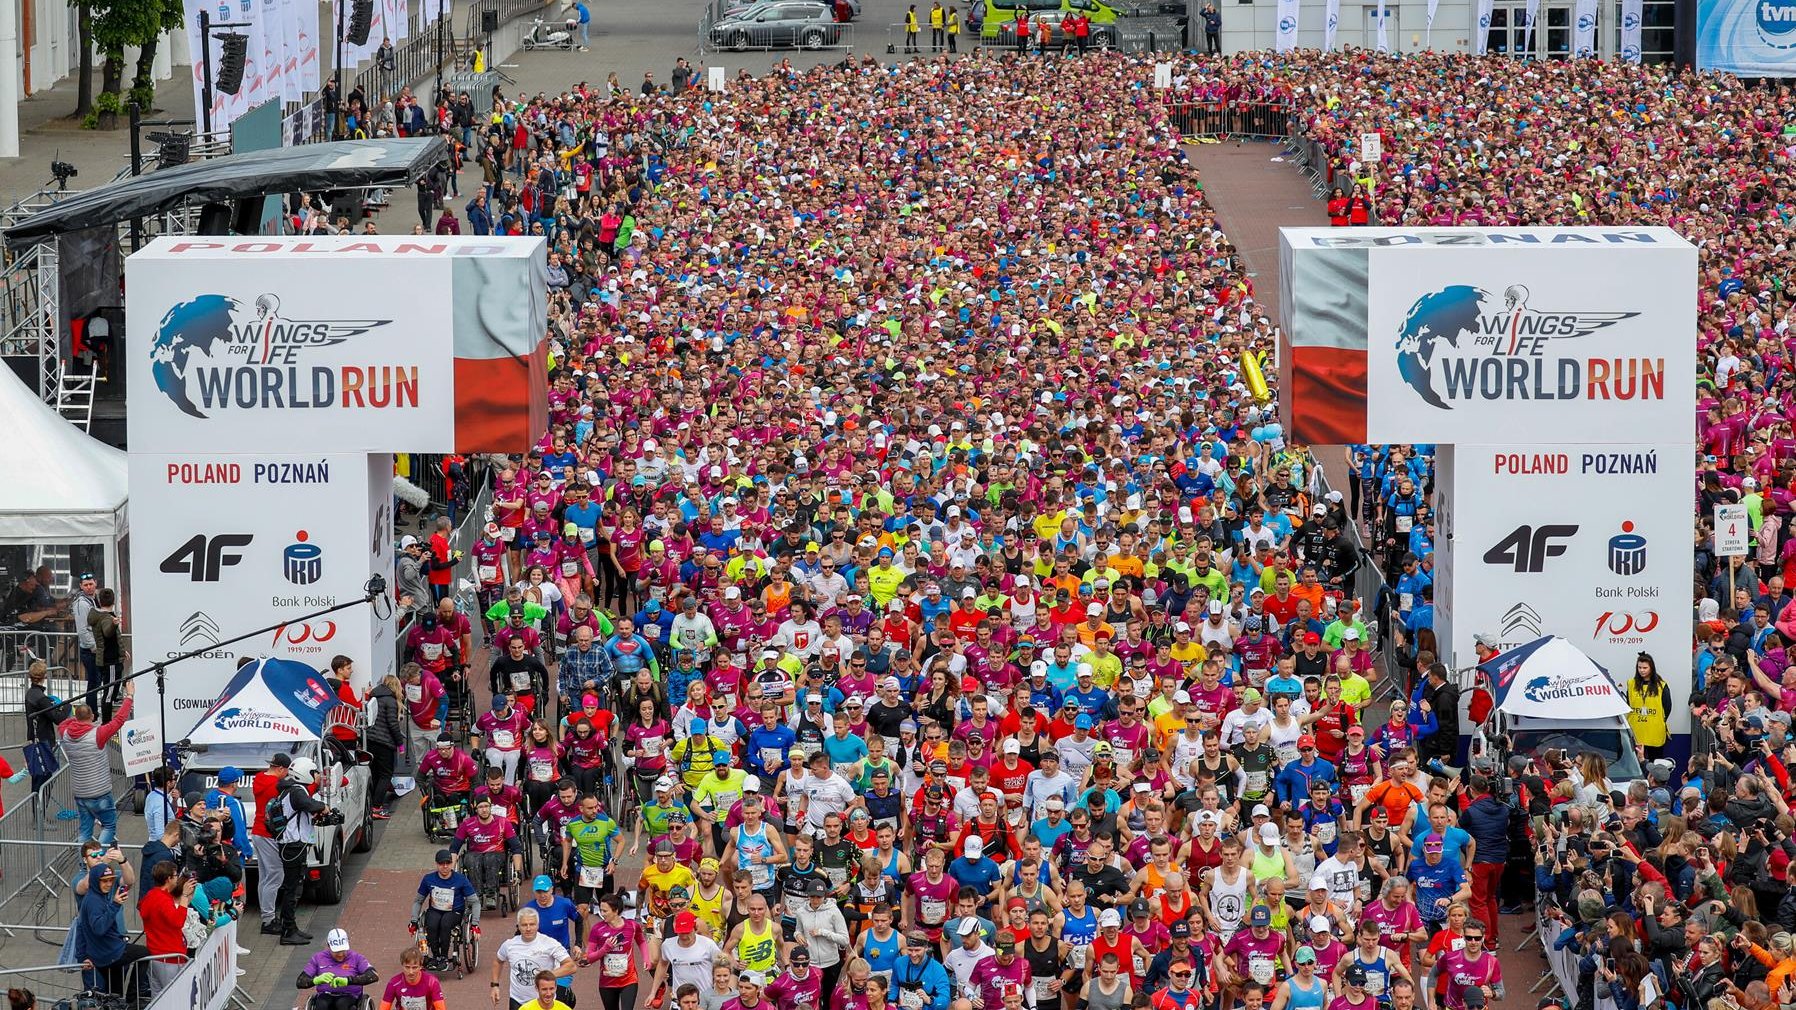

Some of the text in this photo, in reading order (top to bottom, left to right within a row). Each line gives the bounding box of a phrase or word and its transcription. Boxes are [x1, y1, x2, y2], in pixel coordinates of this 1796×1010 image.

[1311, 231, 1657, 246] POZNAŃ
[167, 242, 505, 256] POLAND
[233, 323, 329, 344] WINGS
[1479, 315, 1577, 335] WINGS
[1475, 337, 1495, 346] FOR
[1493, 337, 1549, 356] LIFE
[228, 346, 249, 355] FOR
[246, 346, 301, 364] LIFE
[197, 366, 419, 409] WORLD RUN
[1442, 358, 1664, 400] WORLD RUN
[1495, 450, 1657, 475] POLAND POZNAŃ
[167, 459, 329, 484] POLAND POZNAŃ
[1728, 523, 1736, 537] 4
[1482, 524, 1580, 573] 4F
[159, 534, 254, 582] 4F
[1595, 586, 1659, 598] Bank Polski
[272, 596, 336, 607] Bank Polski
[287, 646, 322, 654] 1919/2019
[1540, 684, 1612, 701] WORLD RUN
[173, 697, 217, 711] CISOWIAN
[228, 719, 300, 736] WORLD RUN
[218, 932, 229, 987] RUN
